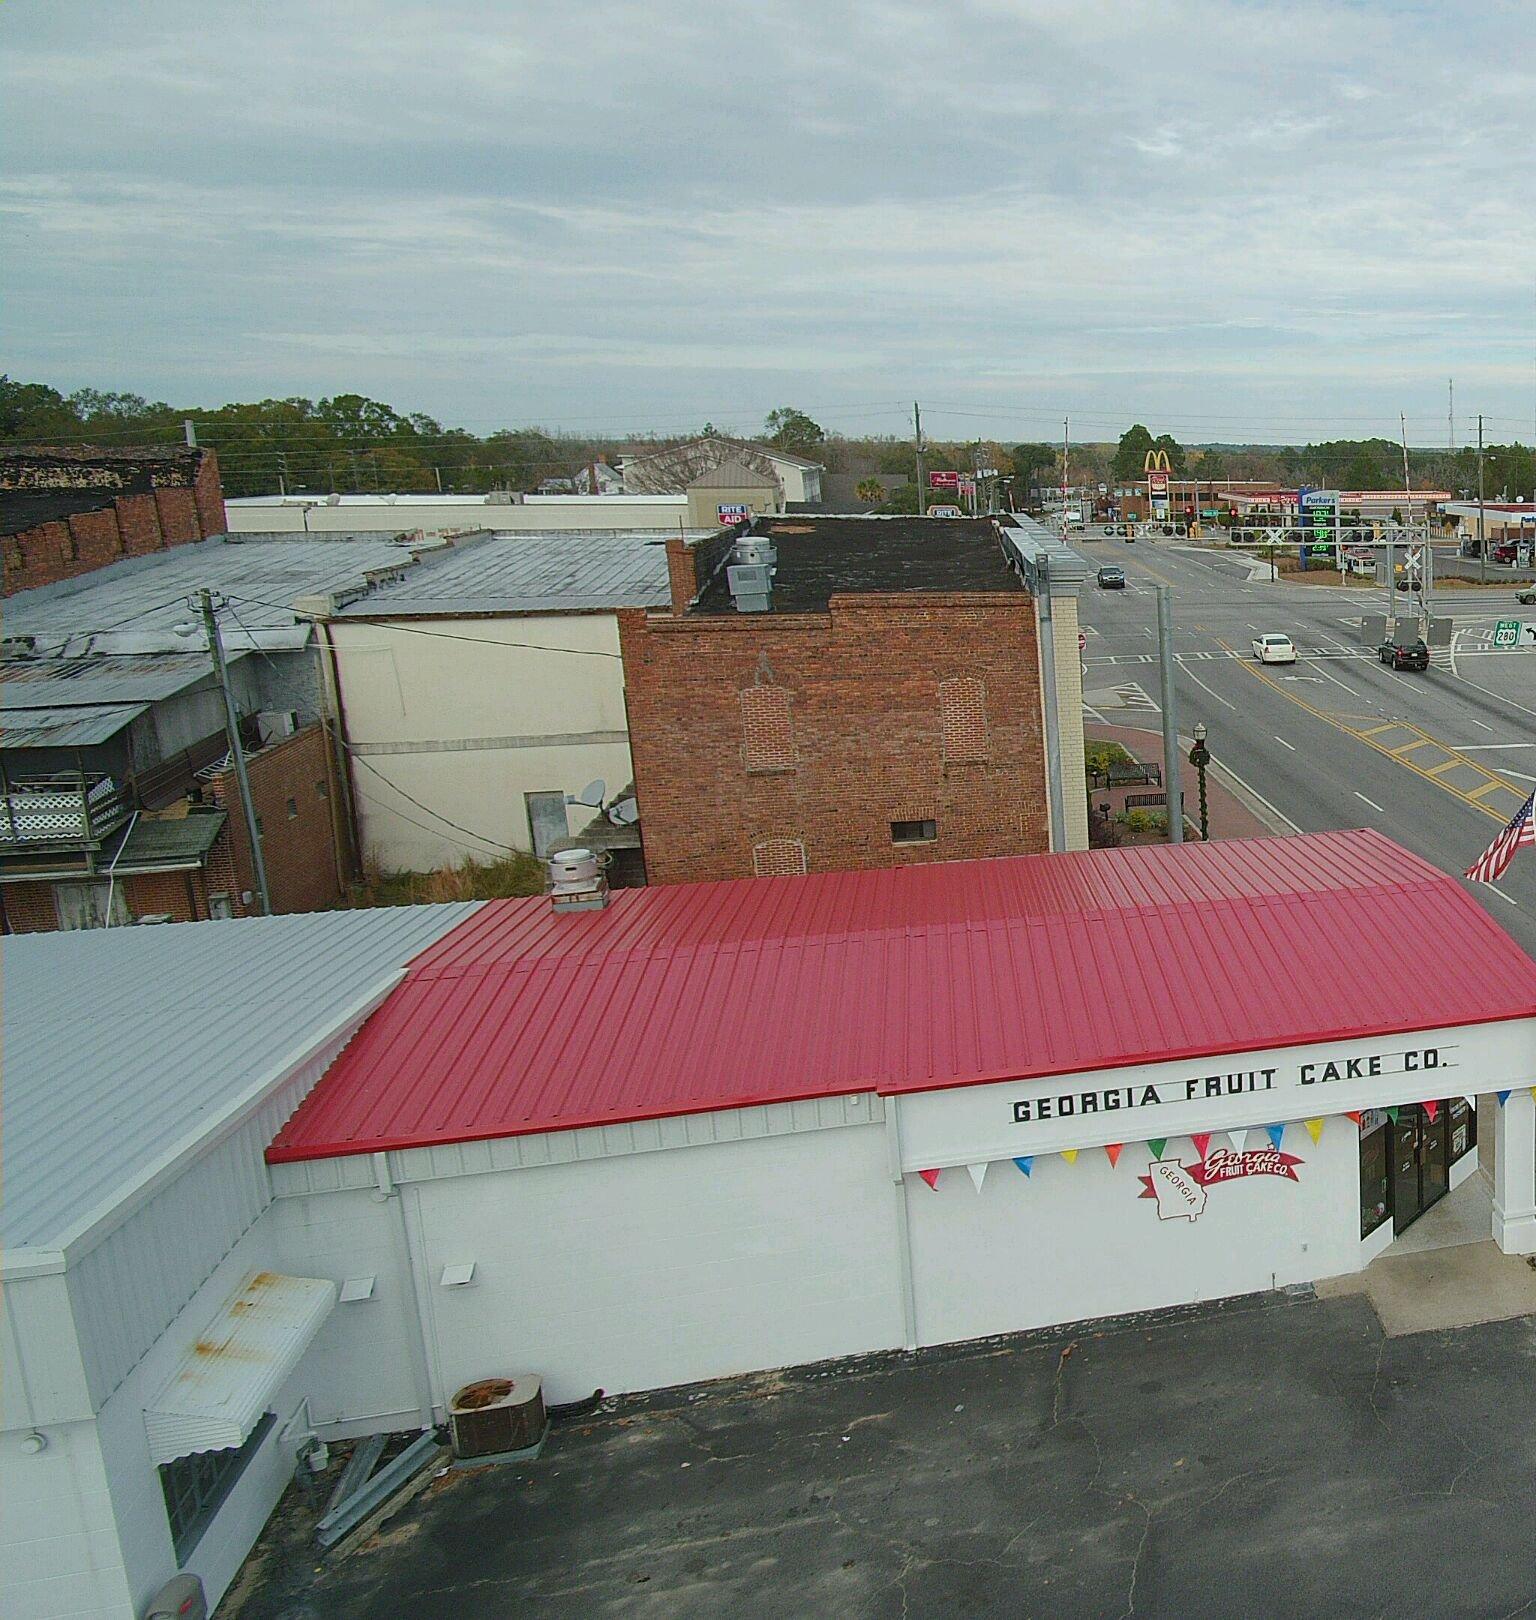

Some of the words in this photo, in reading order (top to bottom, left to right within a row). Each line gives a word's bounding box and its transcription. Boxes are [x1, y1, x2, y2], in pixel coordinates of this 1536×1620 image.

[724, 515, 742, 523] AID
[1498, 631, 1514, 641] 280
[1013, 1084, 1161, 1122] GEORGIA
[1186, 1069, 1276, 1100] FRUIT
[1301, 1056, 1381, 1085] CAKE
[1404, 1049, 1448, 1072] CO.
[1204, 1149, 1281, 1181] Georgia
[1220, 1164, 1244, 1178] FRUIT
[1246, 1161, 1274, 1175] CAKE
[1274, 1165, 1289, 1176] CO.
[1159, 1166, 1197, 1206] GEORGIA
